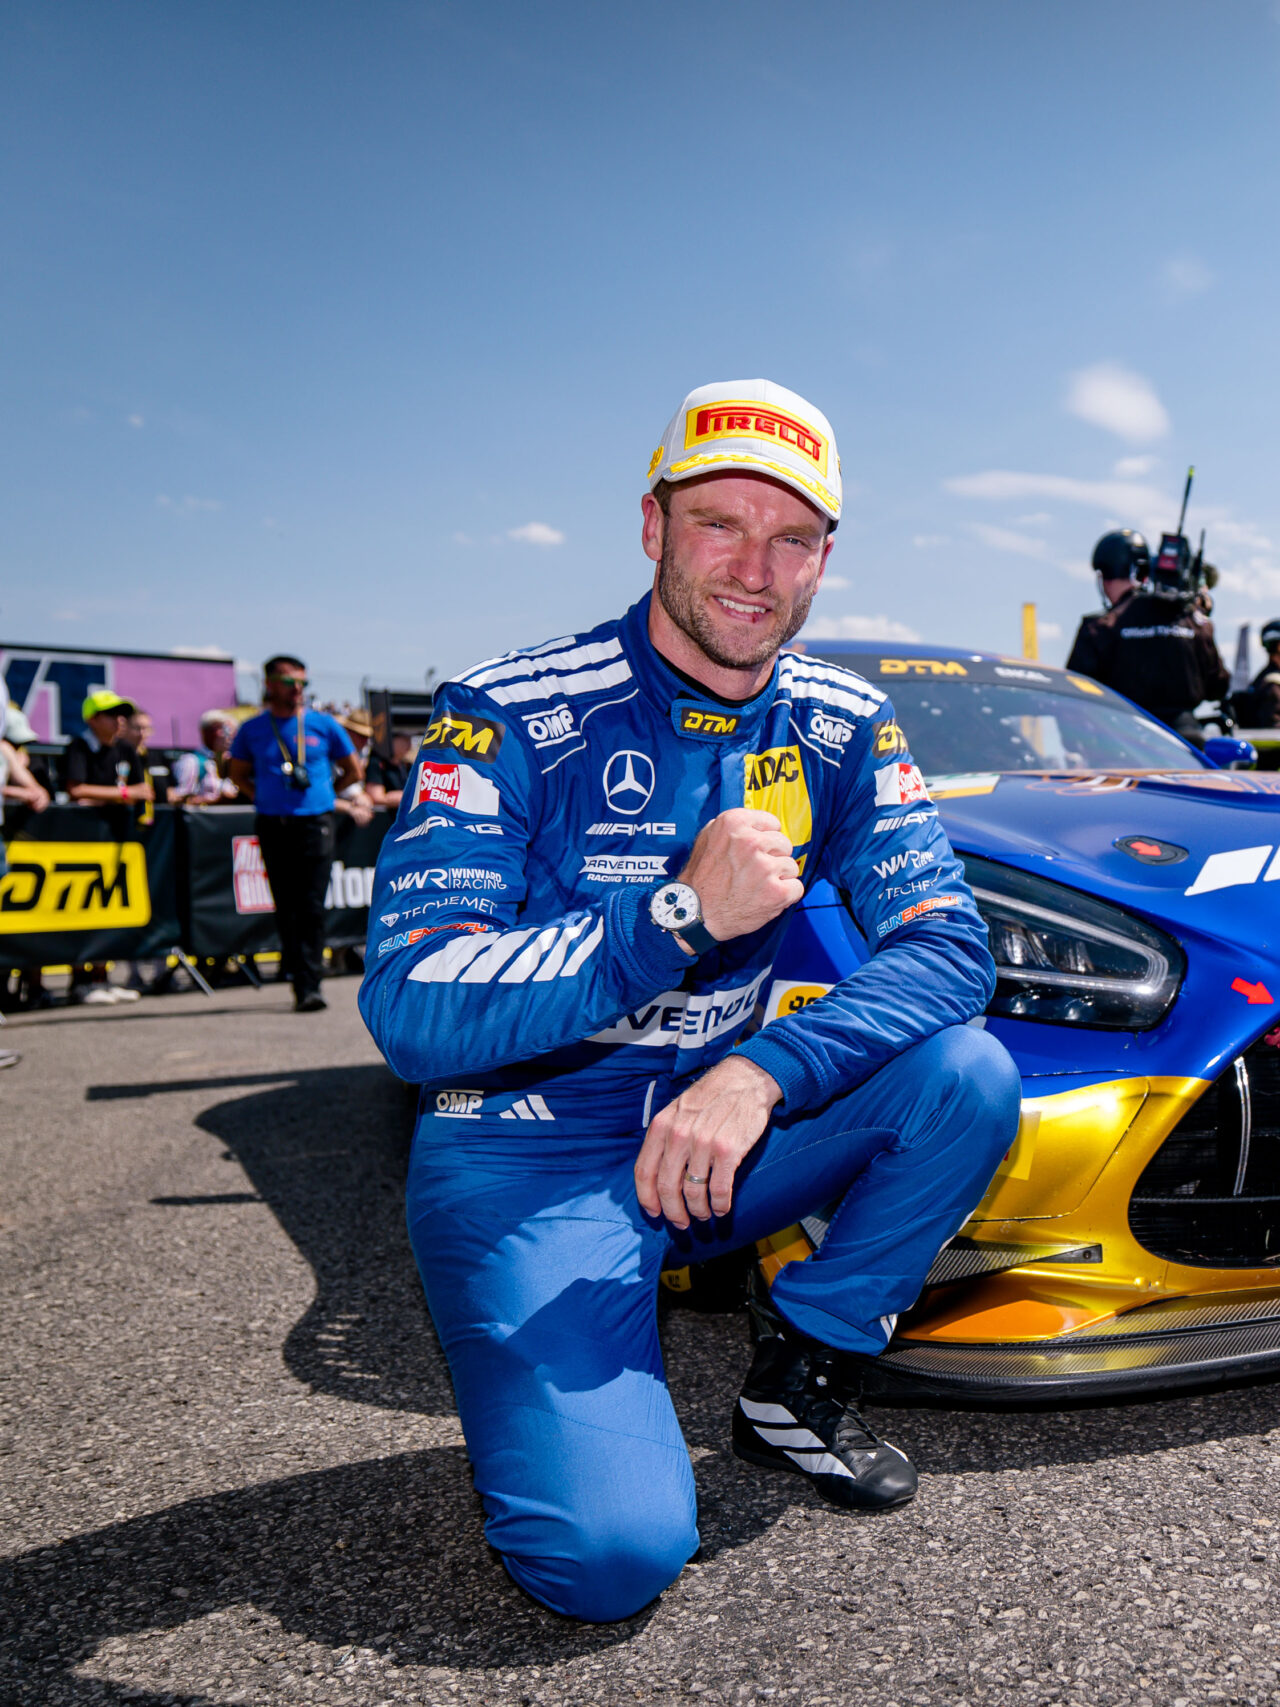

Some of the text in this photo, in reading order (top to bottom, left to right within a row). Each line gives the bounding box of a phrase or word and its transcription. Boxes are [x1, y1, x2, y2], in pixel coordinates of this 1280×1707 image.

[695, 406, 822, 461] PIRELLI
[879, 658, 968, 677] DTM
[526, 711, 575, 741] OMP
[683, 711, 737, 733] DTM
[810, 712, 853, 744] OMP
[422, 716, 494, 755] DTM
[420, 767, 459, 791] Sport
[747, 752, 799, 791] ADAC
[429, 788, 456, 806] Bild
[607, 822, 676, 836] AMG
[451, 868, 502, 883] WINWARD
[587, 860, 659, 870] RAVENOL
[1, 863, 130, 912] DTM
[452, 878, 508, 890] RACING
[587, 873, 654, 883] RACING TEAM
[435, 1090, 483, 1114] OMP
